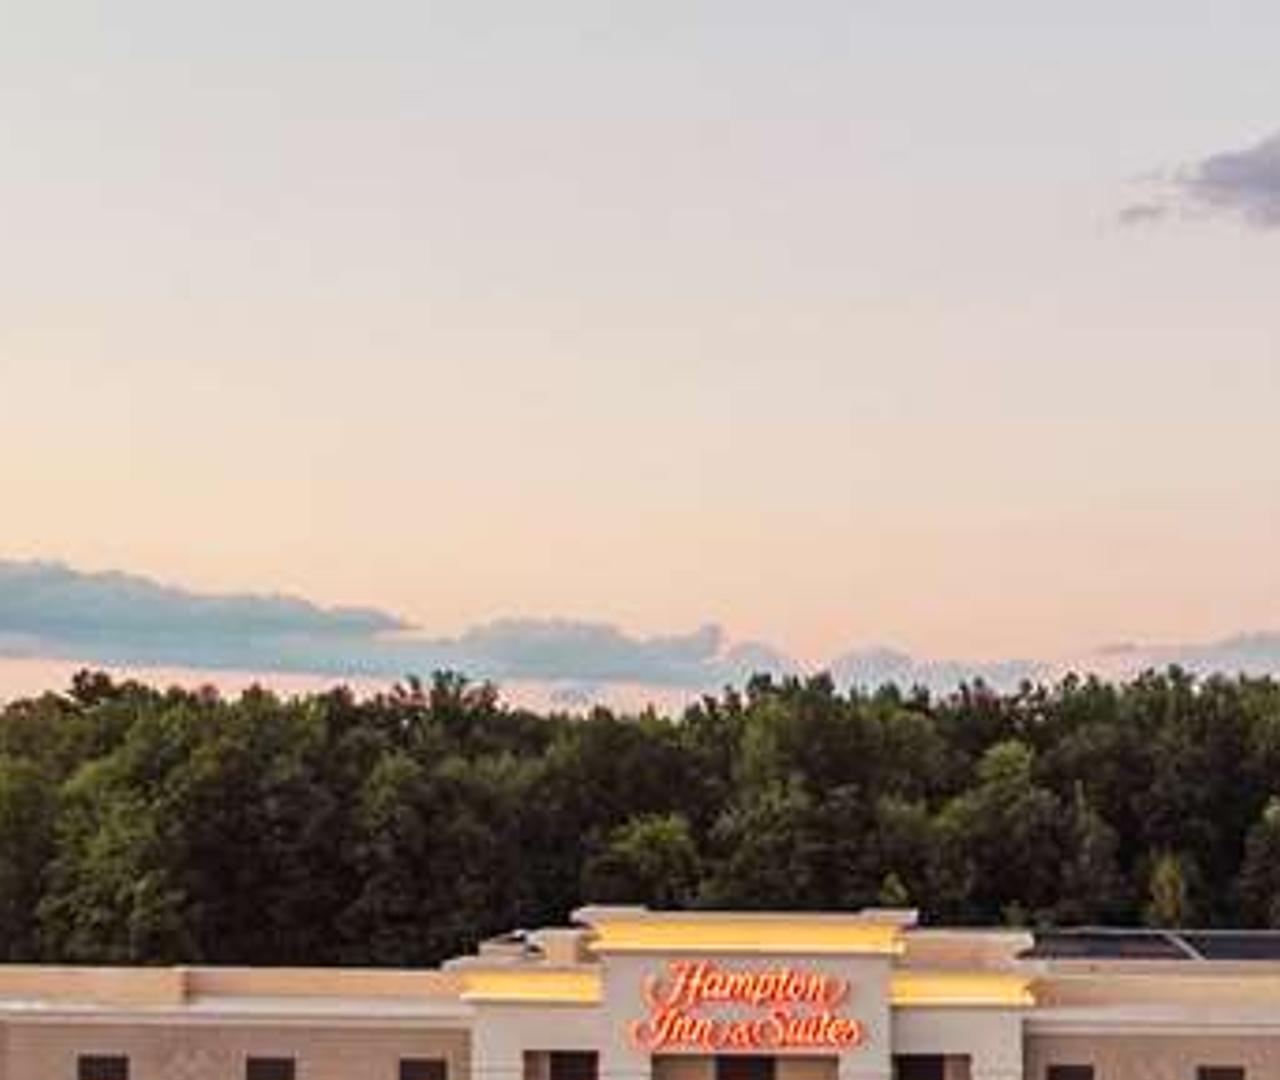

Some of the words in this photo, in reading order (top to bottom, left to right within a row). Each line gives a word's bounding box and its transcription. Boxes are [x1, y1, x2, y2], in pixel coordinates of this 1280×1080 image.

[644, 960, 848, 1006] Hampton
[631, 1005, 715, 1050] Inn
[756, 1007, 861, 1047] Suites
